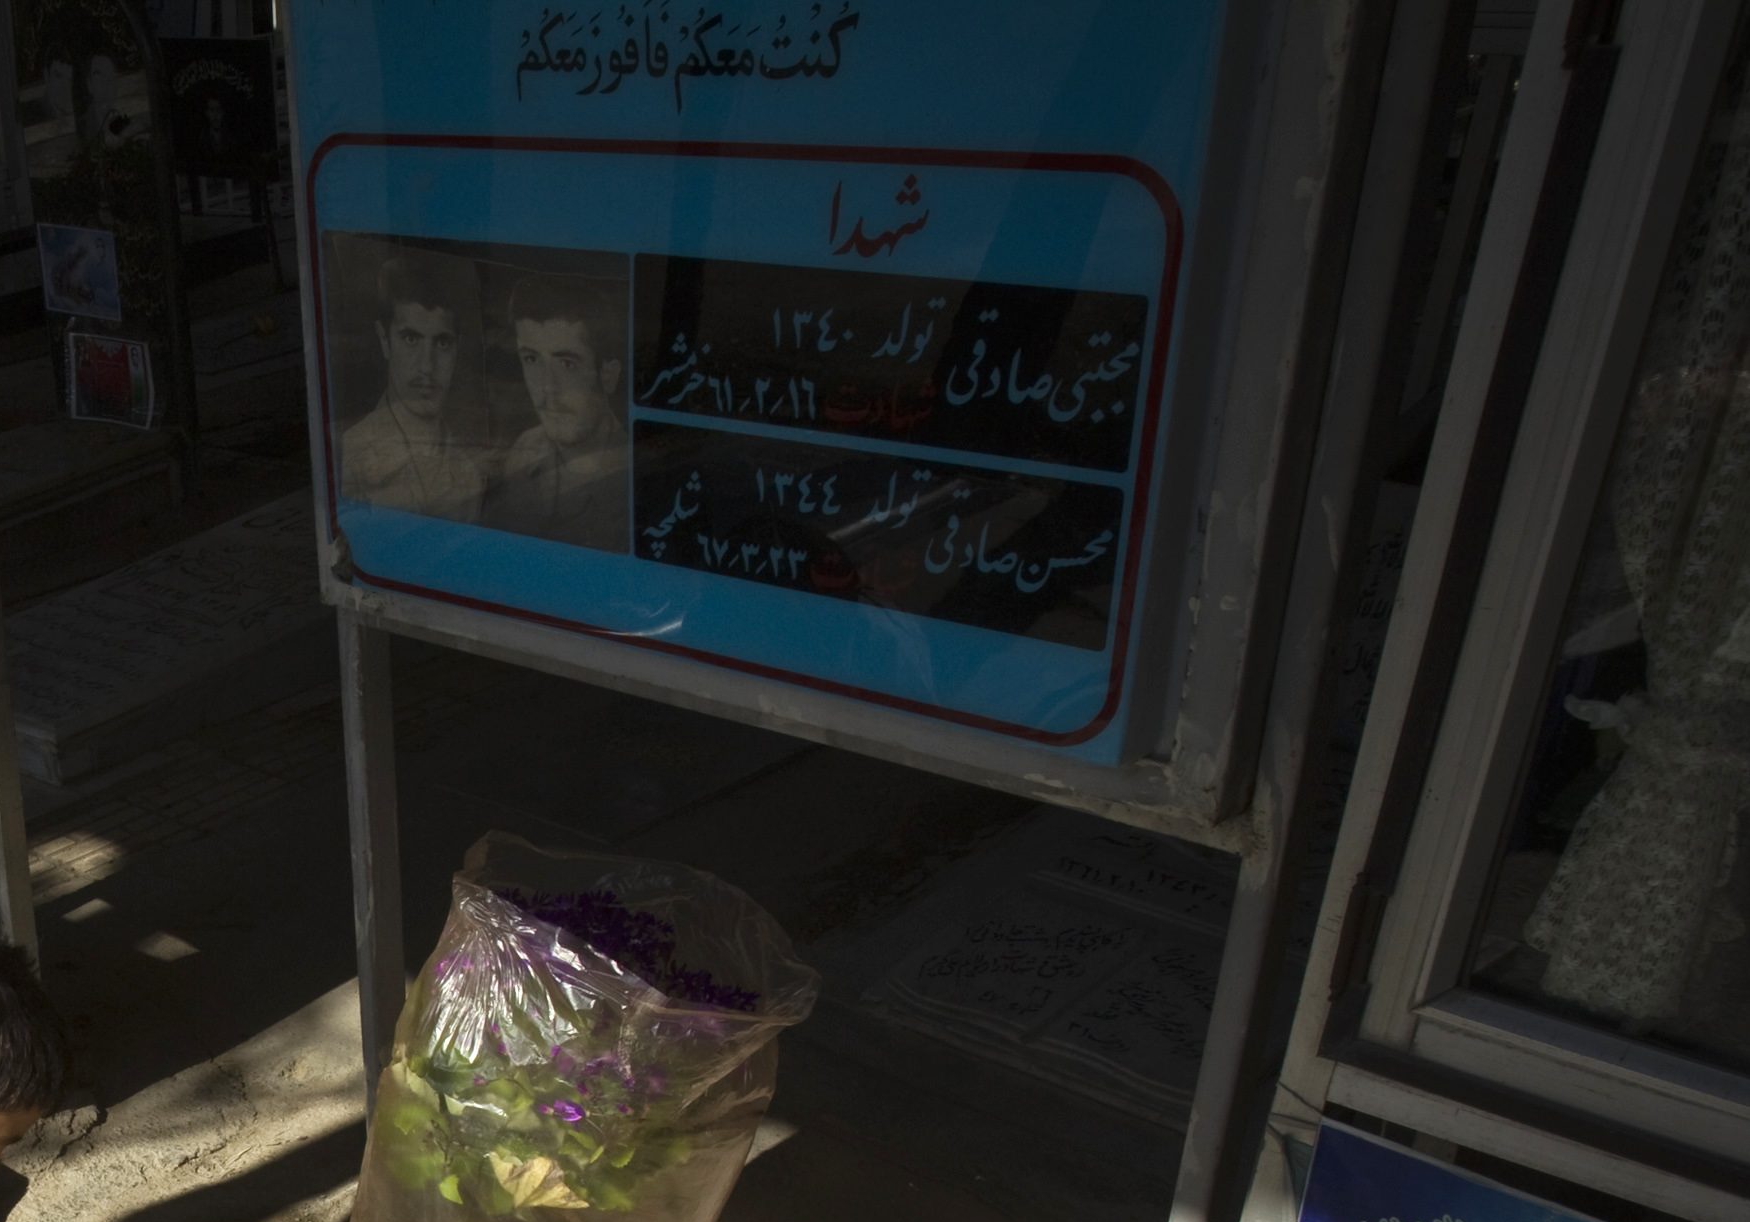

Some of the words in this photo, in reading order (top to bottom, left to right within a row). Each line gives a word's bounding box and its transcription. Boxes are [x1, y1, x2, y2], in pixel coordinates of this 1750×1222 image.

[828, 175, 931, 258] شهدا
[640, 331, 711, 406] خرمشهر
[871, 296, 947, 365] تولد
[944, 309, 1052, 406] صادقی
[1047, 332, 1140, 425] مجتبی
[641, 467, 703, 560] شلمچه
[865, 468, 932, 529] تولد
[923, 487, 1020, 575] صادقی
[1014, 529, 1114, 594] محسن
